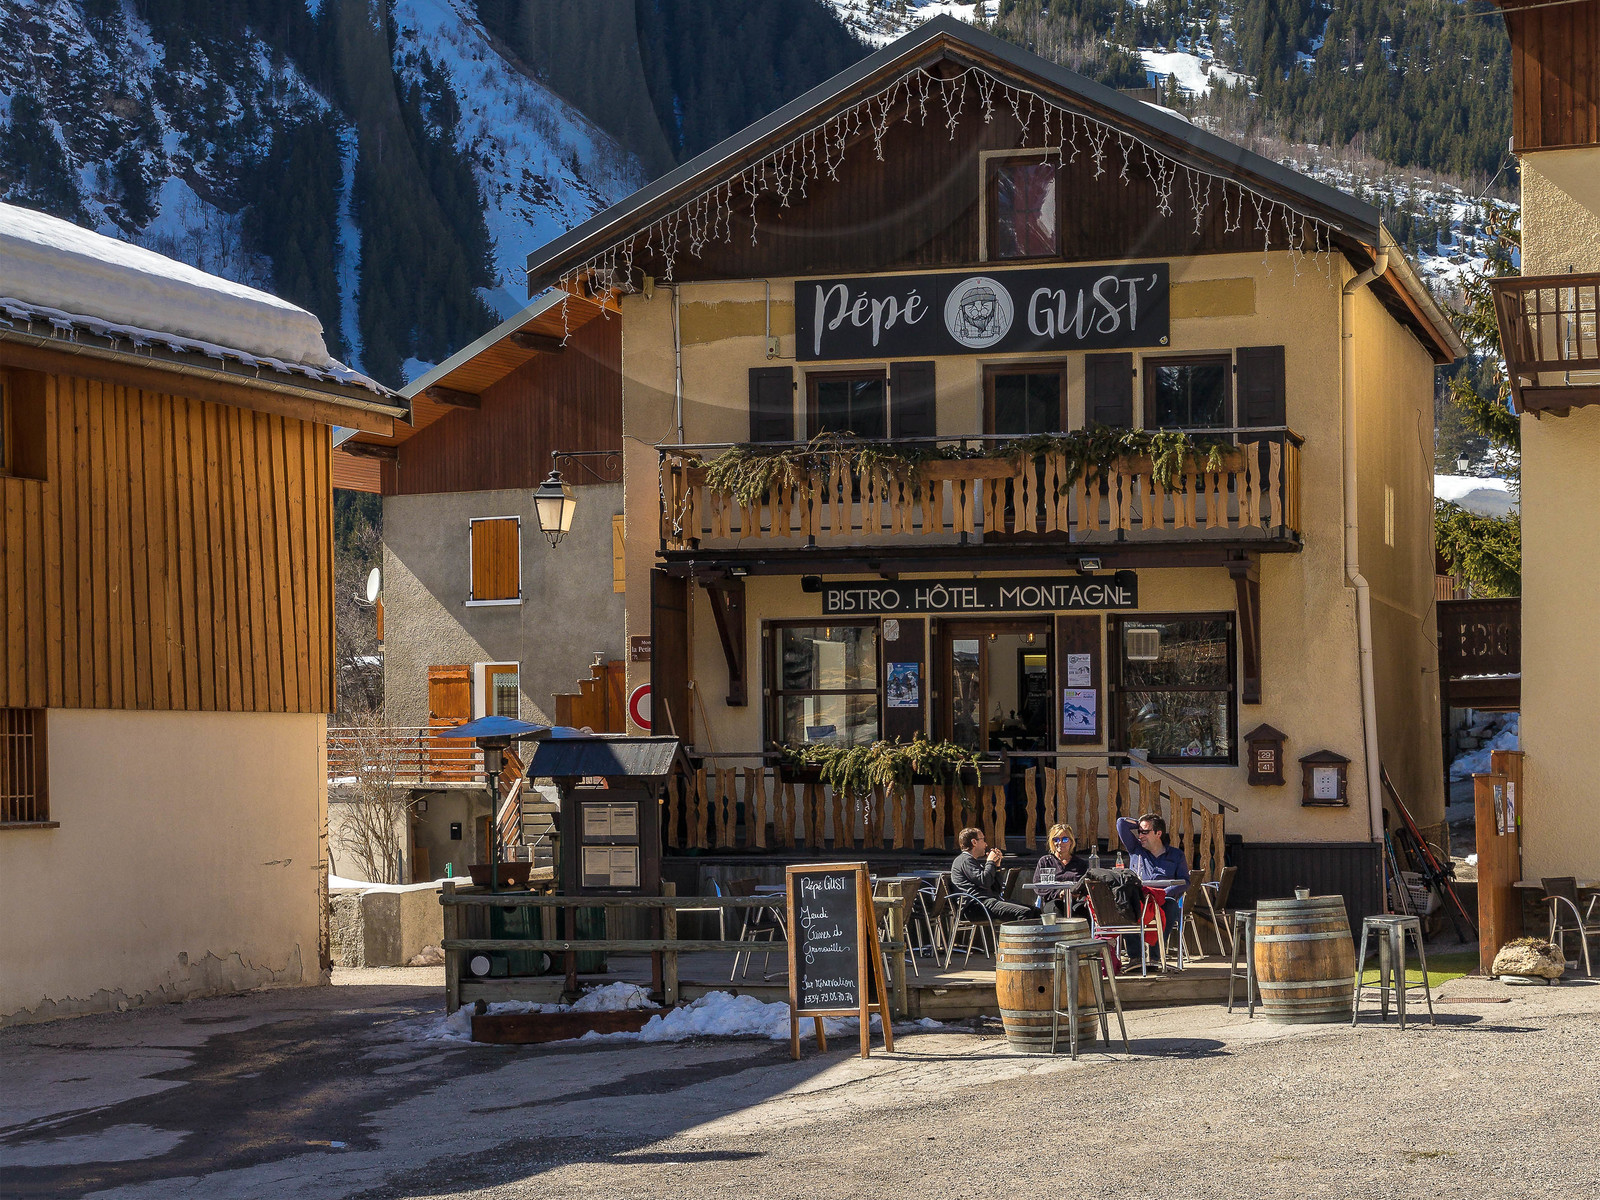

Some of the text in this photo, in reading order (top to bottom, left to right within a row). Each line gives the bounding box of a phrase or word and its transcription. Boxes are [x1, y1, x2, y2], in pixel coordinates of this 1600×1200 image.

[813, 284, 928, 356] Pépé
[827, 583, 1132, 612] BISTRO HÔTEL MONTAGNE
[1261, 751, 1271, 759] 29
